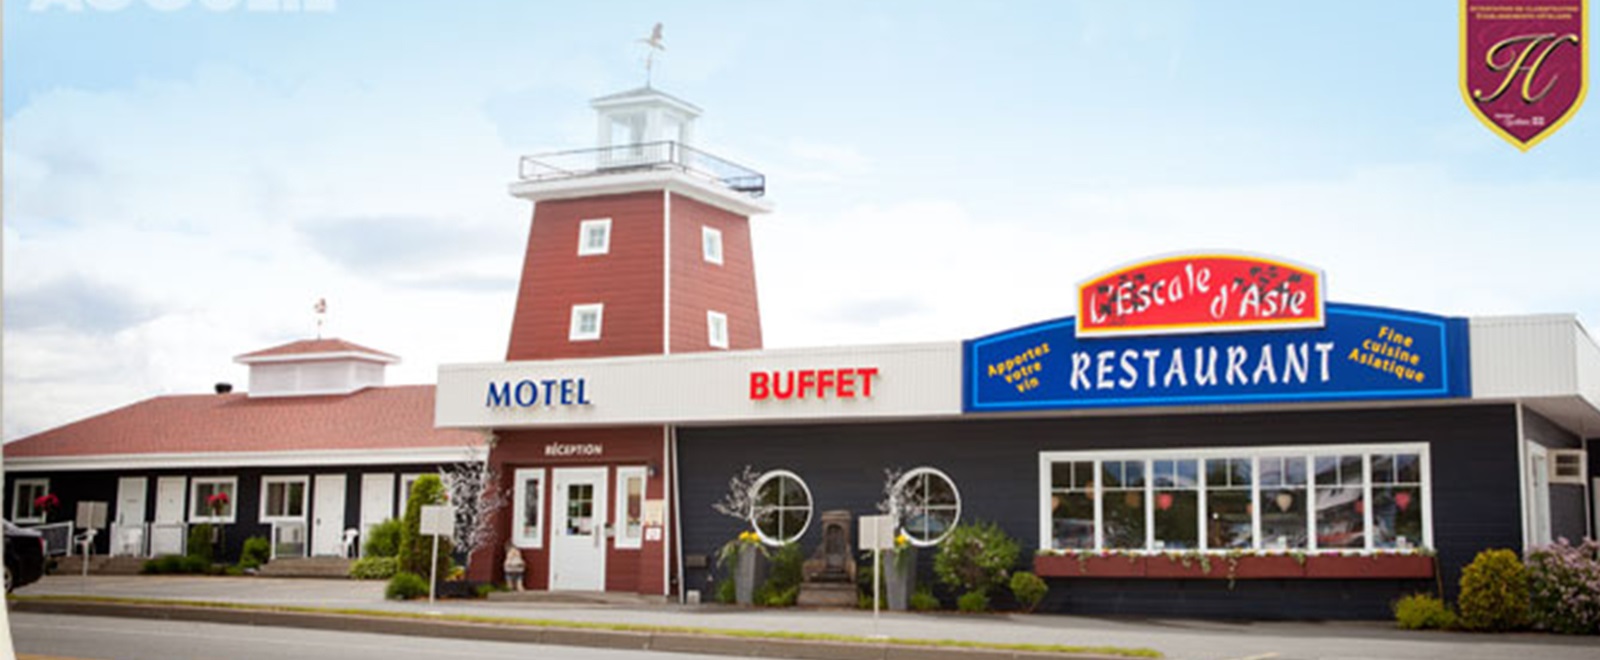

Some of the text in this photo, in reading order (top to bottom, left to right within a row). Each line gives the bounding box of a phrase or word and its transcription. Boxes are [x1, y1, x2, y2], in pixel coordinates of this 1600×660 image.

[1090, 263, 1307, 324] L'Escale d'Asie
[1378, 326, 1413, 348] Fine
[988, 342, 1050, 377] Apportez
[1069, 342, 1334, 390] RESTAURANT
[1347, 348, 1426, 383] Asiatique
[1362, 339, 1420, 366] cuisine
[750, 367, 879, 401] BUFFET
[1004, 361, 1042, 384] votre
[1016, 377, 1039, 393] vin
[485, 378, 591, 408] MOTEL
[544, 442, 603, 456] RÉCEPTION
